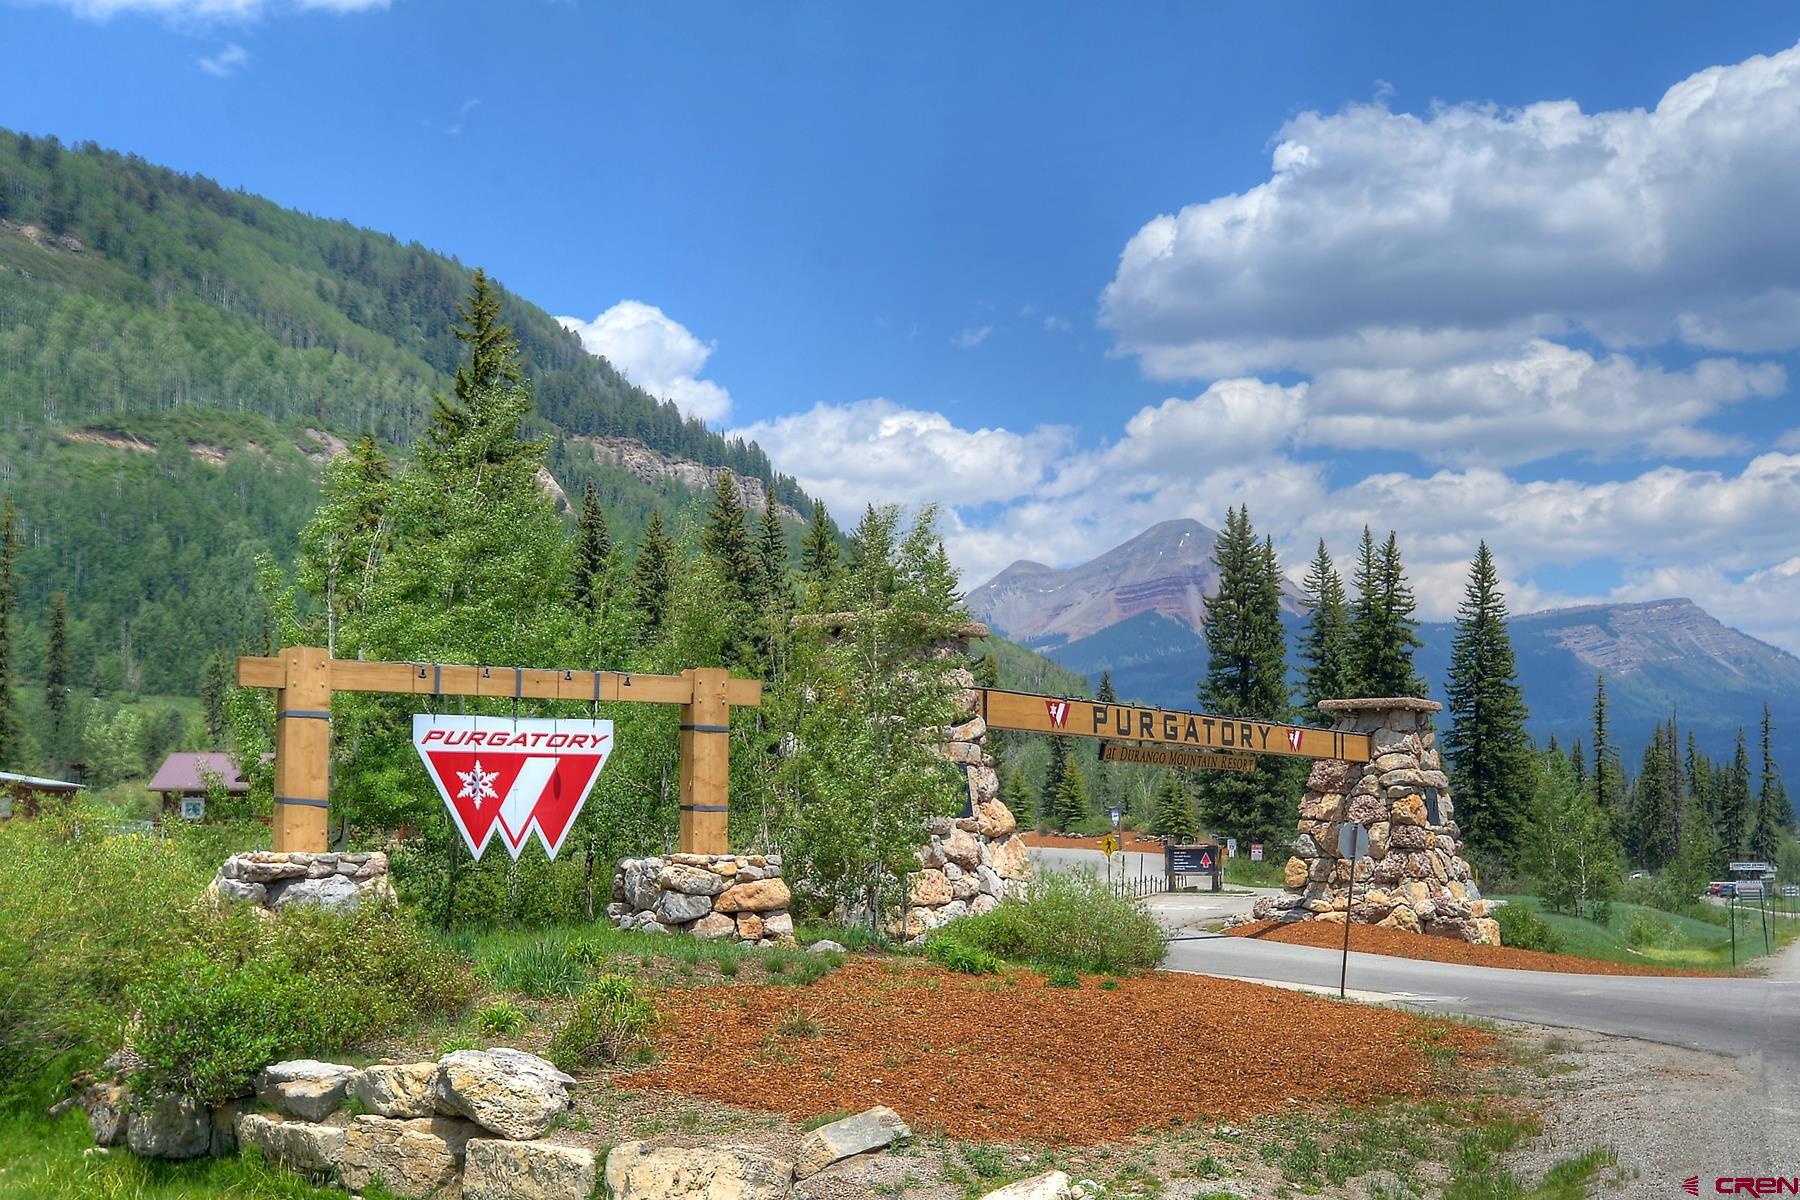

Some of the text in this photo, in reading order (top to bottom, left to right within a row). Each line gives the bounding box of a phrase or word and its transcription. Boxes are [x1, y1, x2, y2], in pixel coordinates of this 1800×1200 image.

[422, 730, 609, 748] PURGATORY
[1093, 706, 1271, 749] PURGATORY
[1106, 746, 1254, 771] at DURANGO MOUNTAIN RESORT
